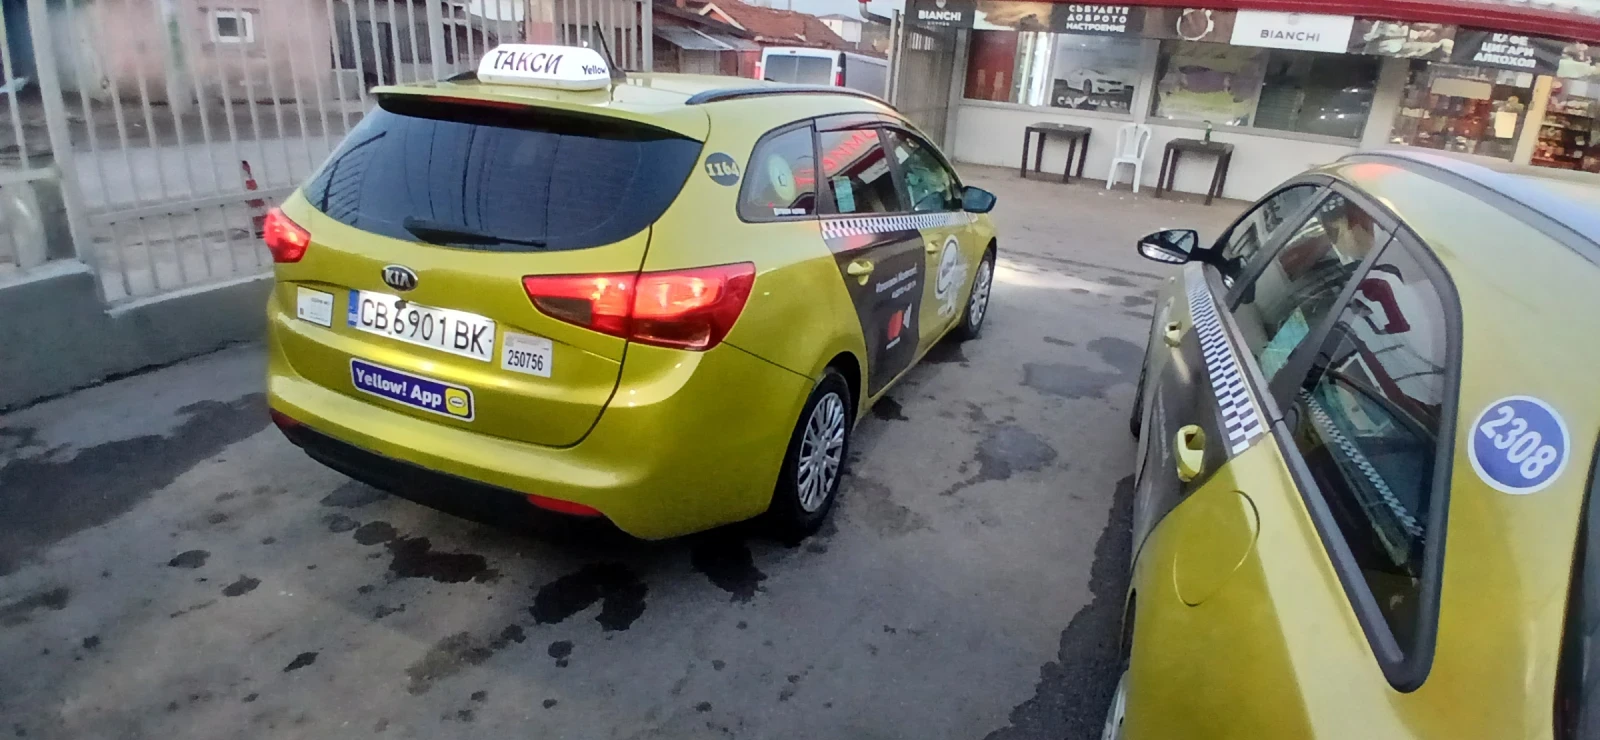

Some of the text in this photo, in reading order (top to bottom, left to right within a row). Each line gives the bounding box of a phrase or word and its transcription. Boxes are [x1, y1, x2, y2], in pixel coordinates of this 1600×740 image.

[918, 9, 962, 21] BIANCHI
[1066, 13, 1127, 24] ДОБРОТО
[1065, 22, 1126, 33] НАСТРОЕНИЕ
[1260, 29, 1321, 42] BIANCHI
[1481, 41, 1535, 57] ЦИГАРИ
[493, 50, 564, 75] ТАКСИ
[1473, 52, 1537, 69] АЛКОХОЛ
[706, 161, 740, 177] 1164
[384, 269, 411, 288] KIA
[507, 349, 544, 372] 250756
[355, 367, 443, 409] Yellow! App
[1480, 405, 1557, 480] 2308
